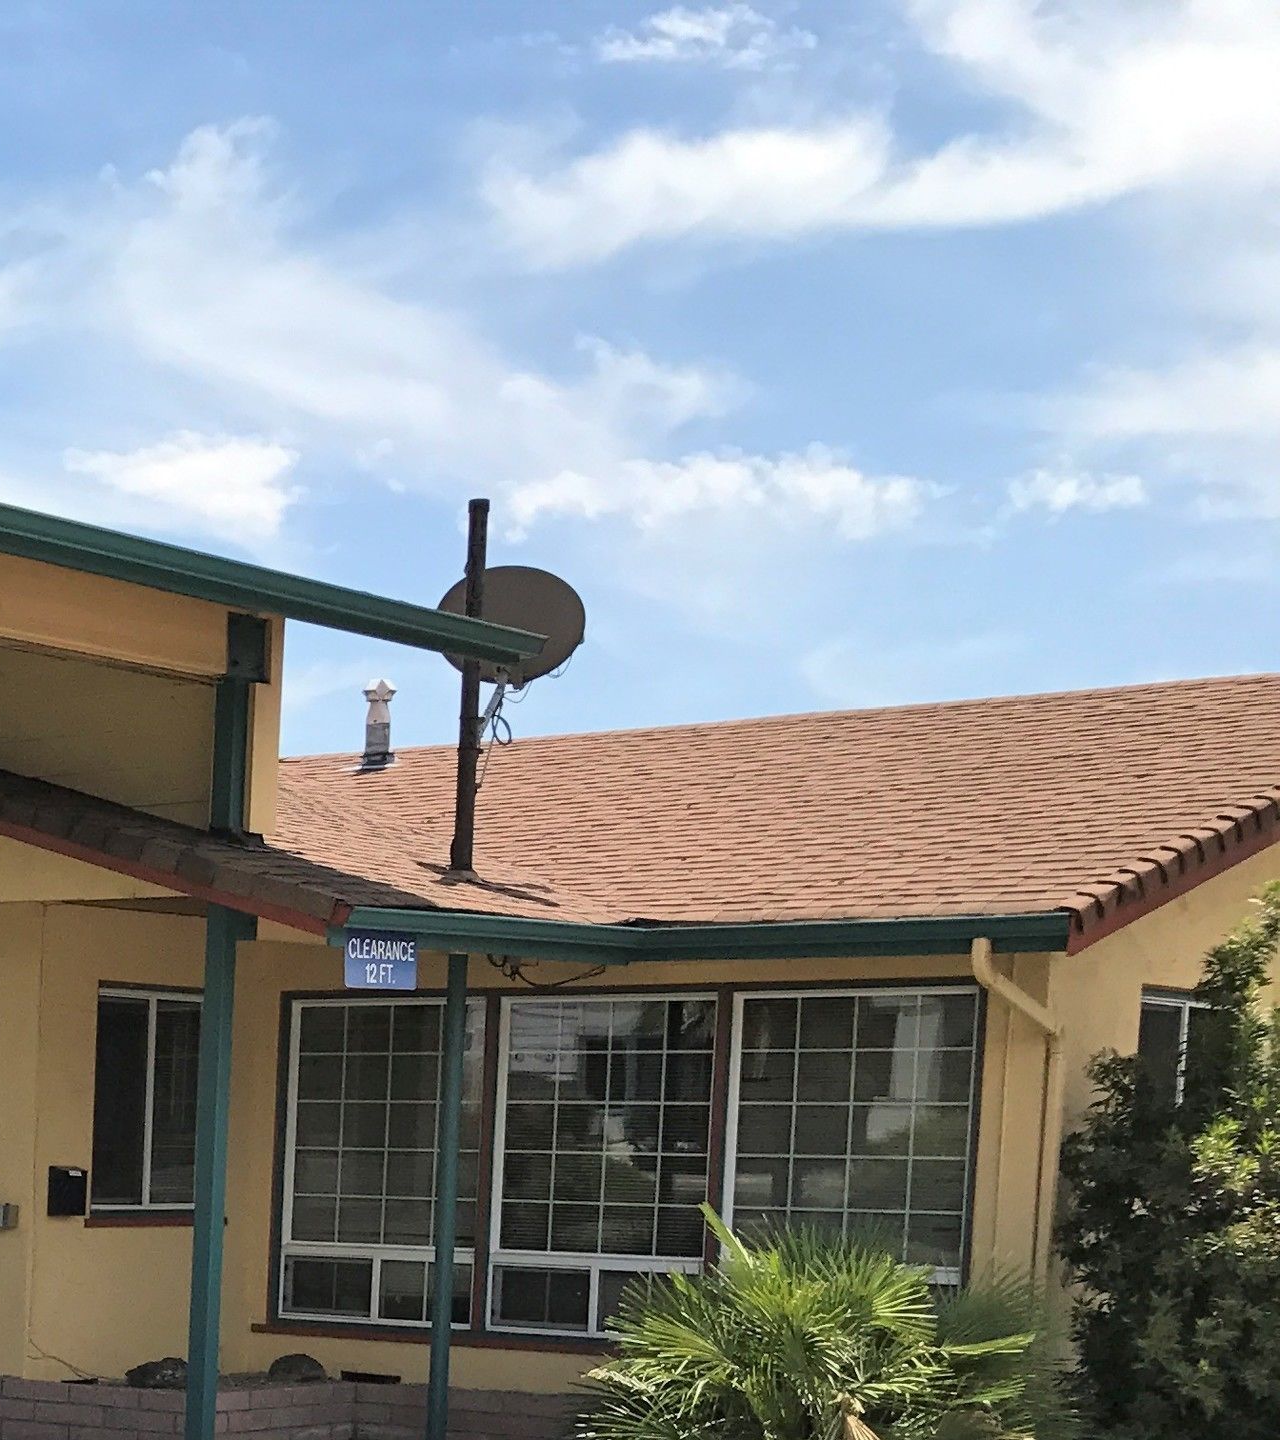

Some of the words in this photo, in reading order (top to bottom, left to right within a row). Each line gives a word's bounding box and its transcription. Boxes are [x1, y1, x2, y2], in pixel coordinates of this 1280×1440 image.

[348, 937, 416, 962] CLEARANCE
[365, 963, 377, 984] 12
[380, 963, 396, 984] FT.
